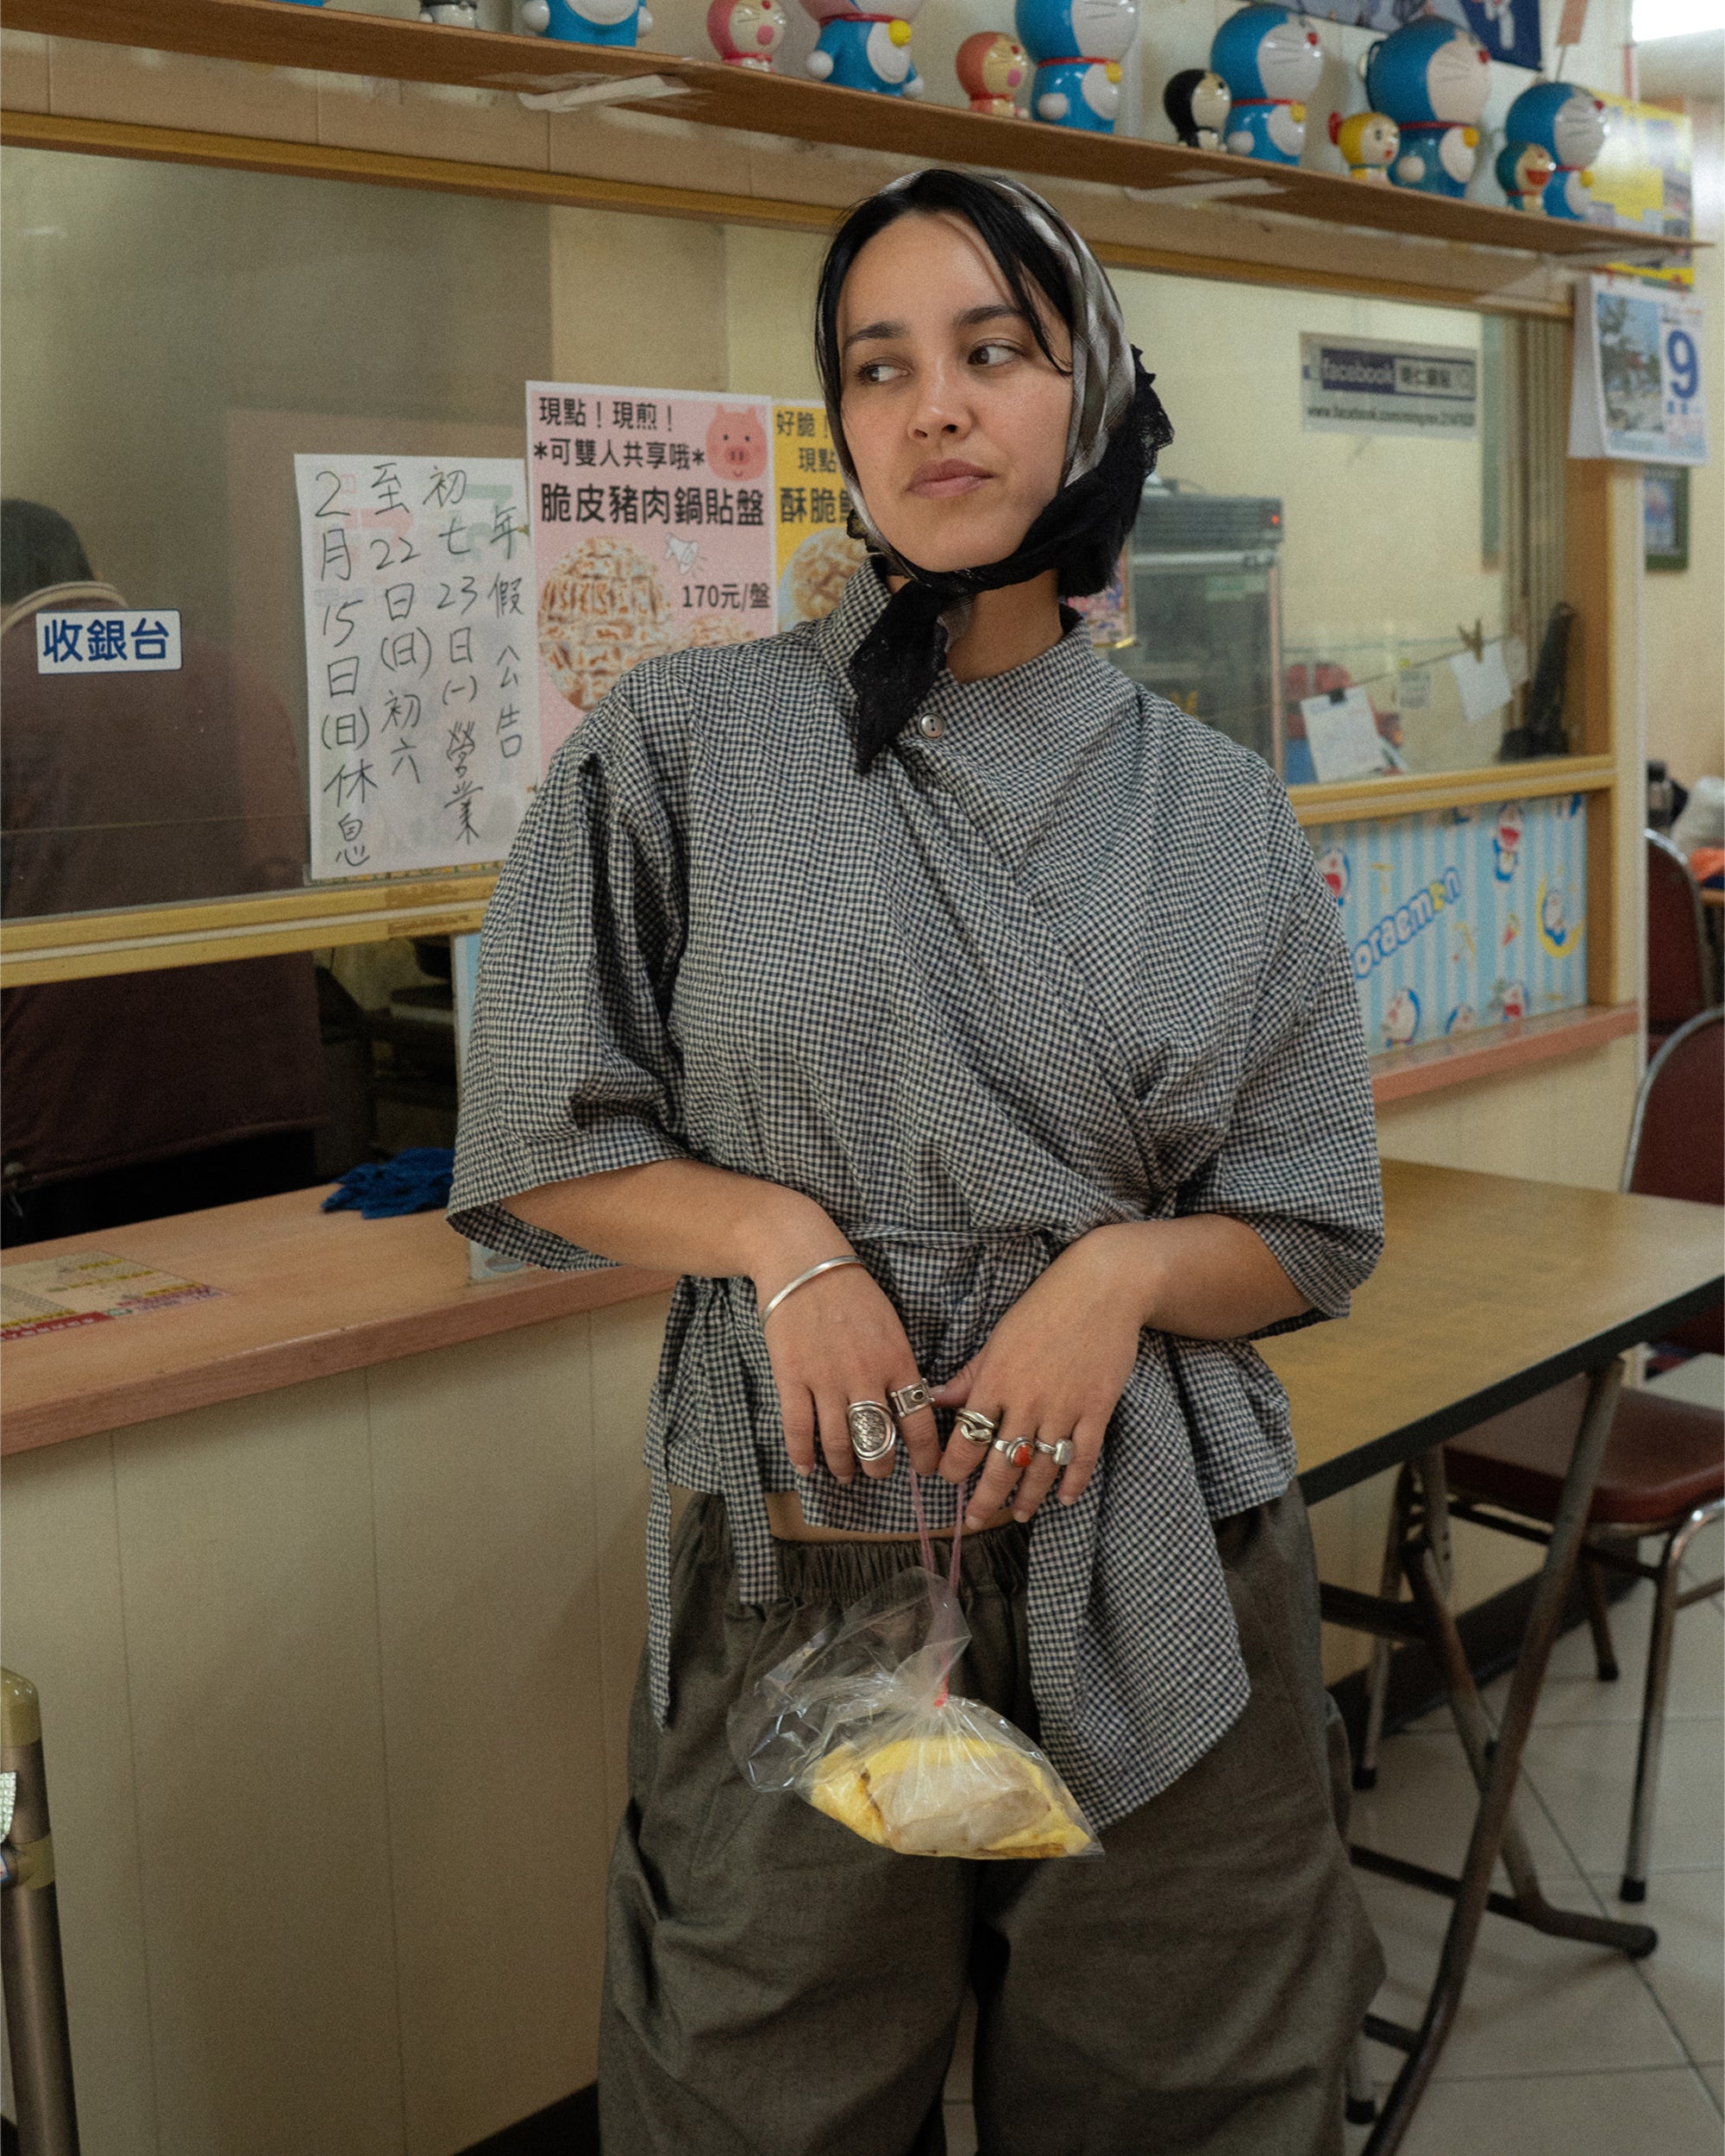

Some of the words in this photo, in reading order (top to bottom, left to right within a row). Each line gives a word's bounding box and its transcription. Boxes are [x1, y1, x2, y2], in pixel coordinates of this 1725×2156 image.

[1667, 329, 1699, 399] 9
[541, 483, 764, 526] 脆皮豬肉鍋貼盤
[682, 581, 771, 611] 170元/盤
[43, 617, 169, 663] 收銀台
[1350, 867, 1463, 980] oraemon
